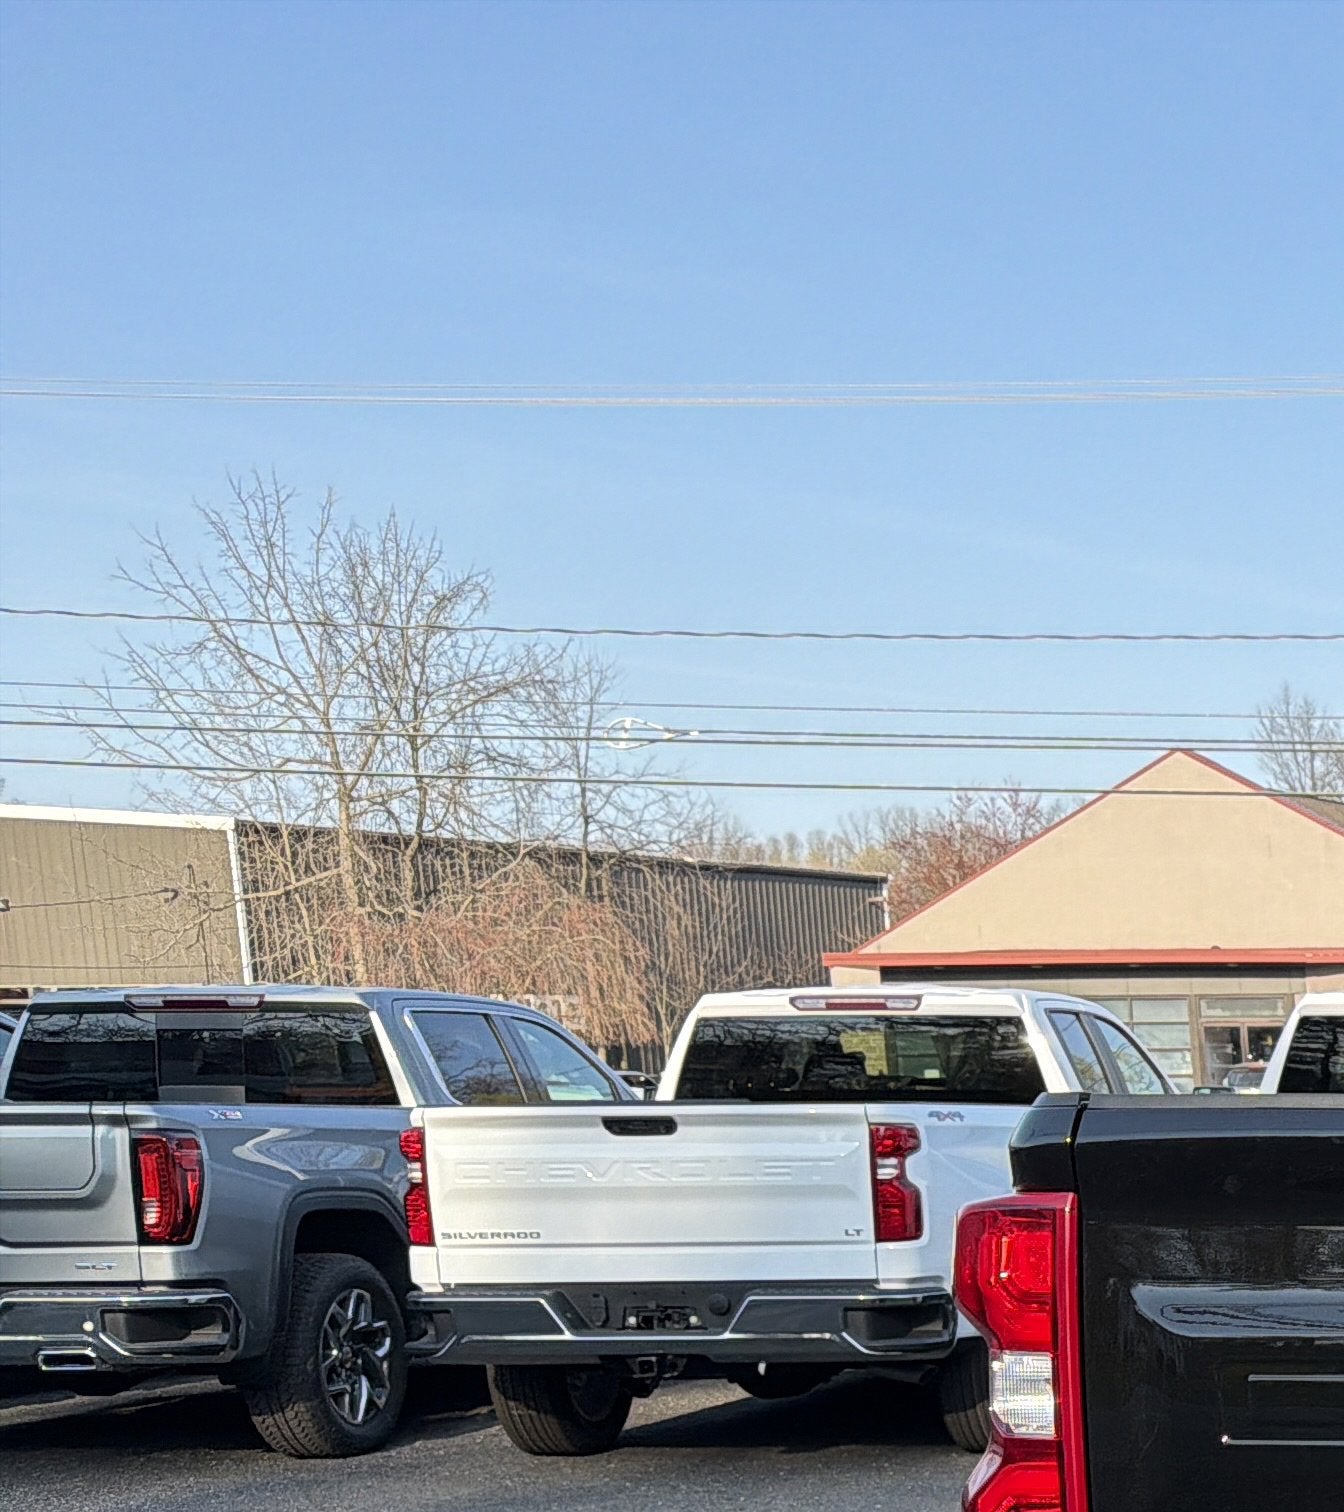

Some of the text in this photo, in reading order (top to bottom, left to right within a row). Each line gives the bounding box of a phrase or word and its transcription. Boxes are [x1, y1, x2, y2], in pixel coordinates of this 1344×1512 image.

[453, 1159, 836, 1184] CHEVROLET
[440, 1231, 542, 1240] SILVERADO
[844, 1228, 865, 1237] LT
